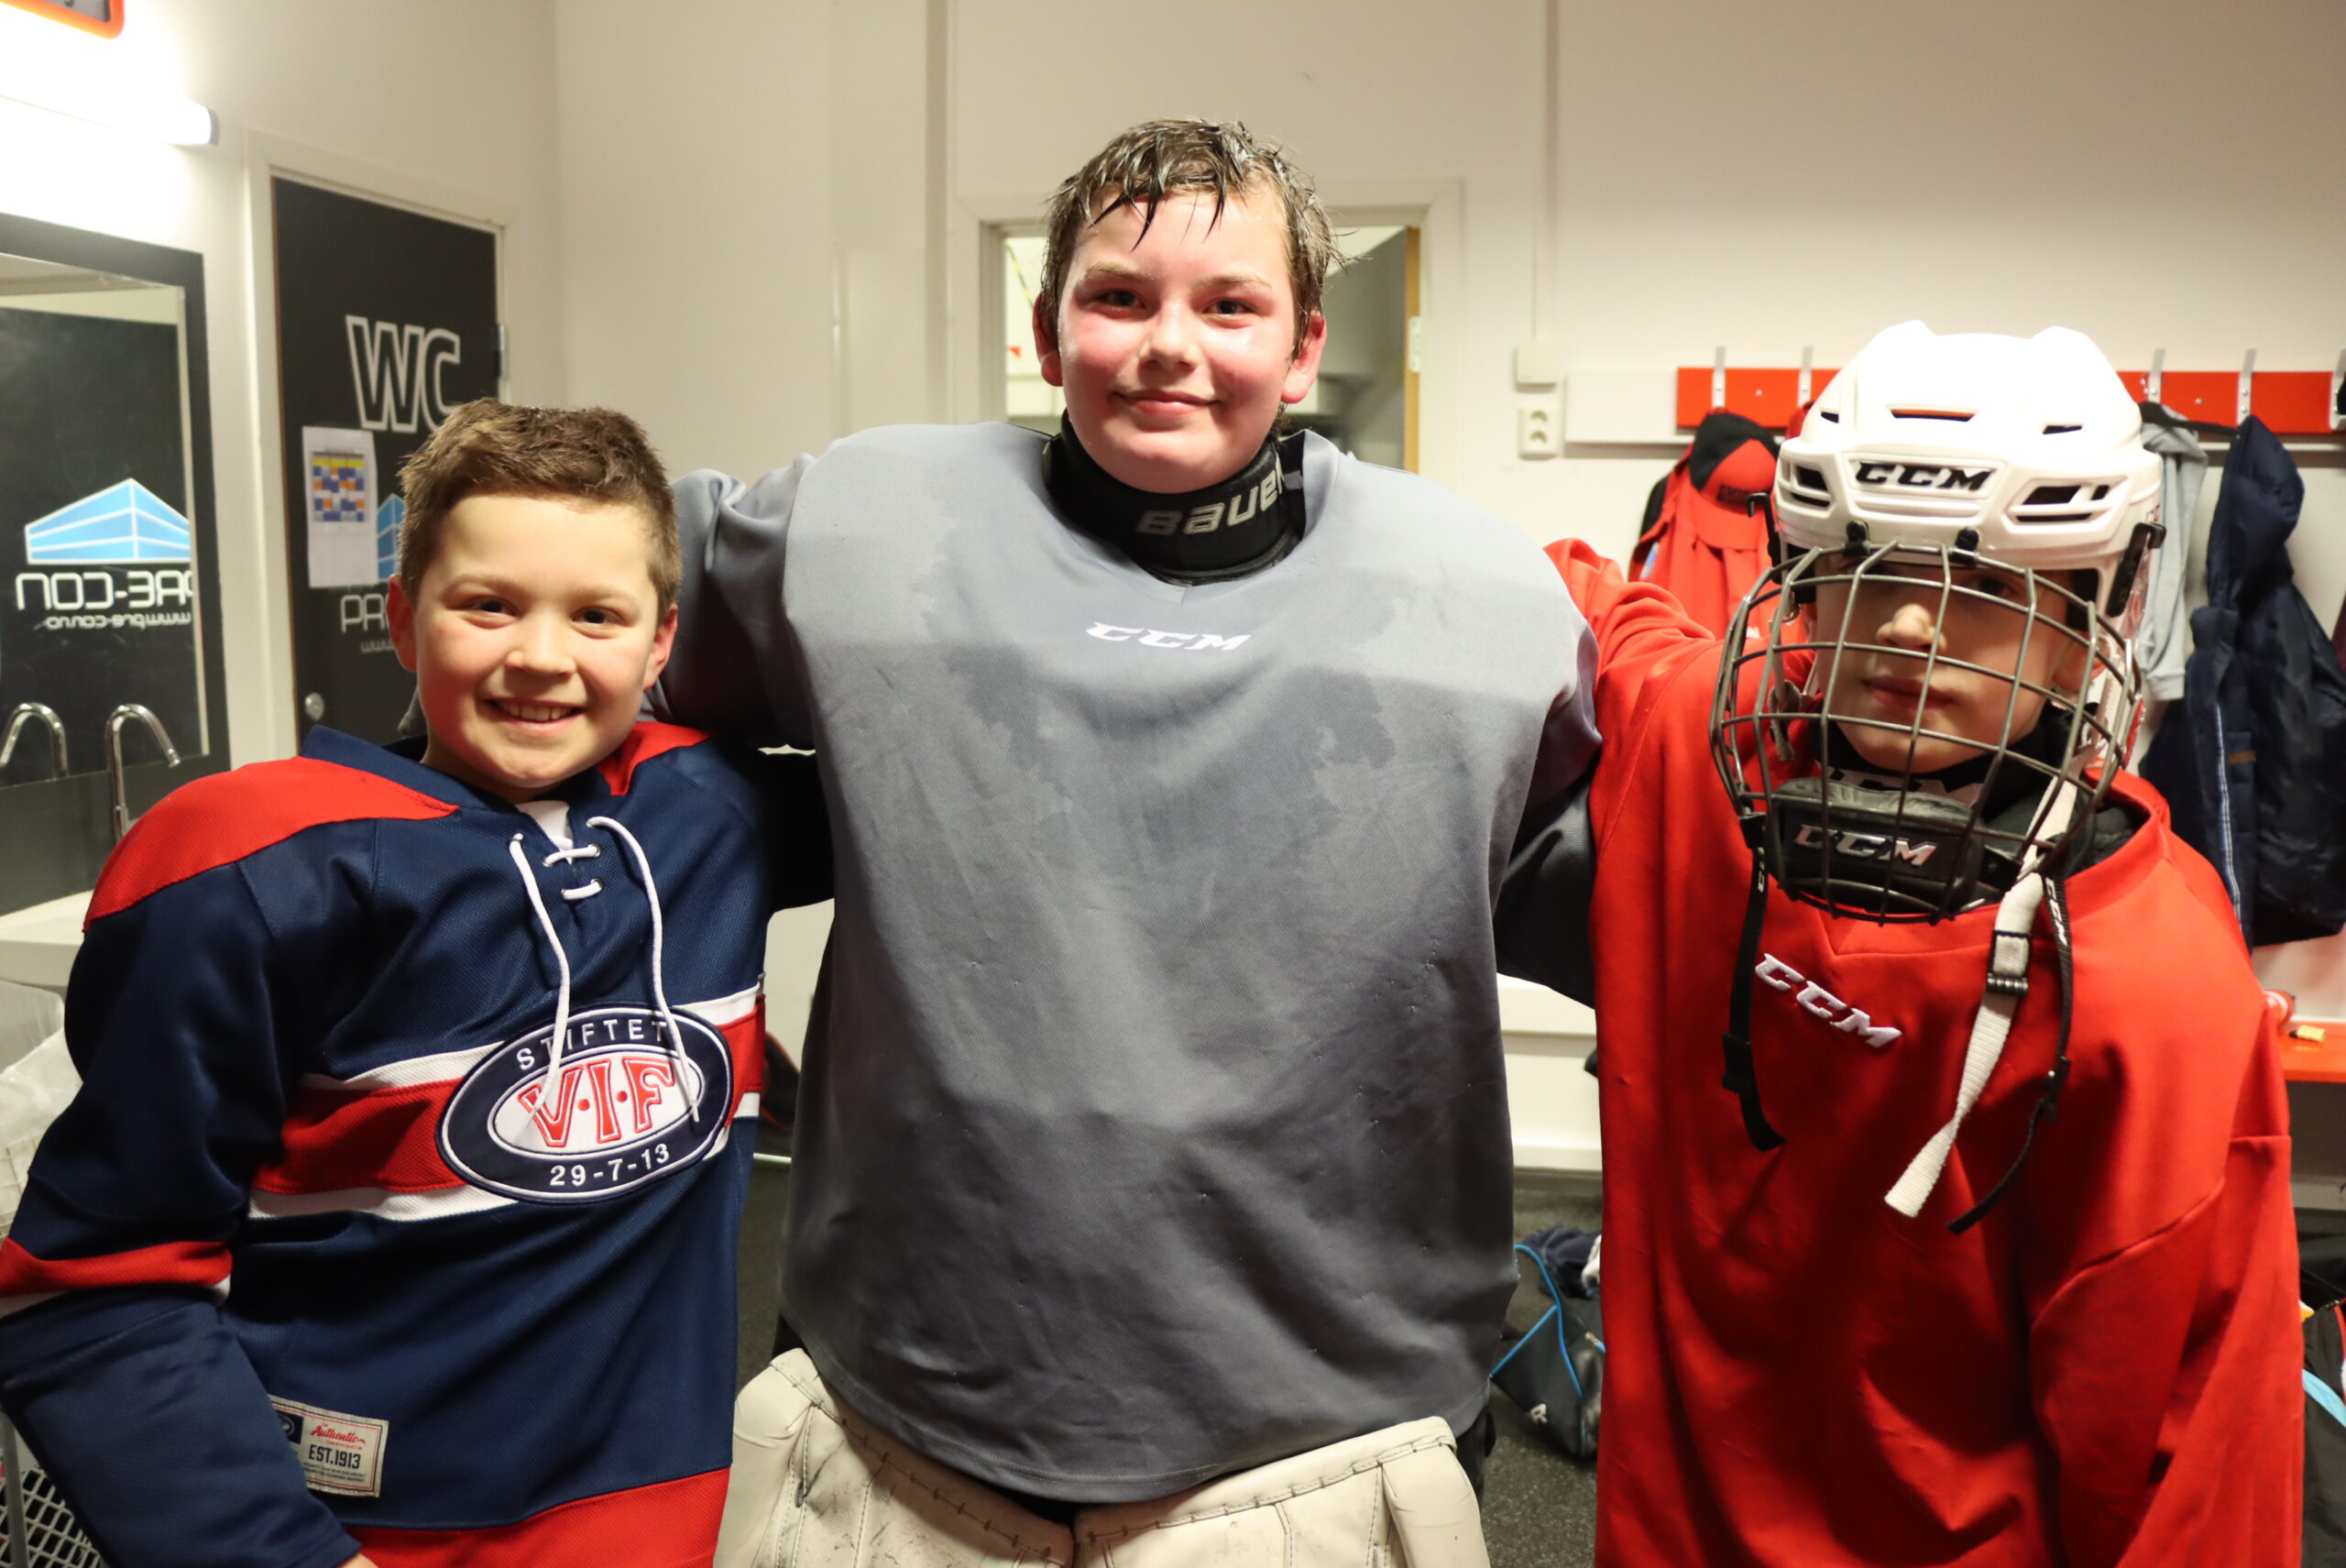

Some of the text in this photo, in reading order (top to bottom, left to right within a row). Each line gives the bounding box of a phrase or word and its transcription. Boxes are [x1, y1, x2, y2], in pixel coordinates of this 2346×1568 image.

[345, 314, 461, 434] WC
[1856, 461, 1995, 493] CCM
[1086, 622, 1253, 651] CCM
[1795, 824, 1937, 867] CCM
[1755, 952, 1903, 1048] CCM
[550, 1143, 671, 1187] 29-7-13
[308, 1444, 361, 1470] EST.1913
